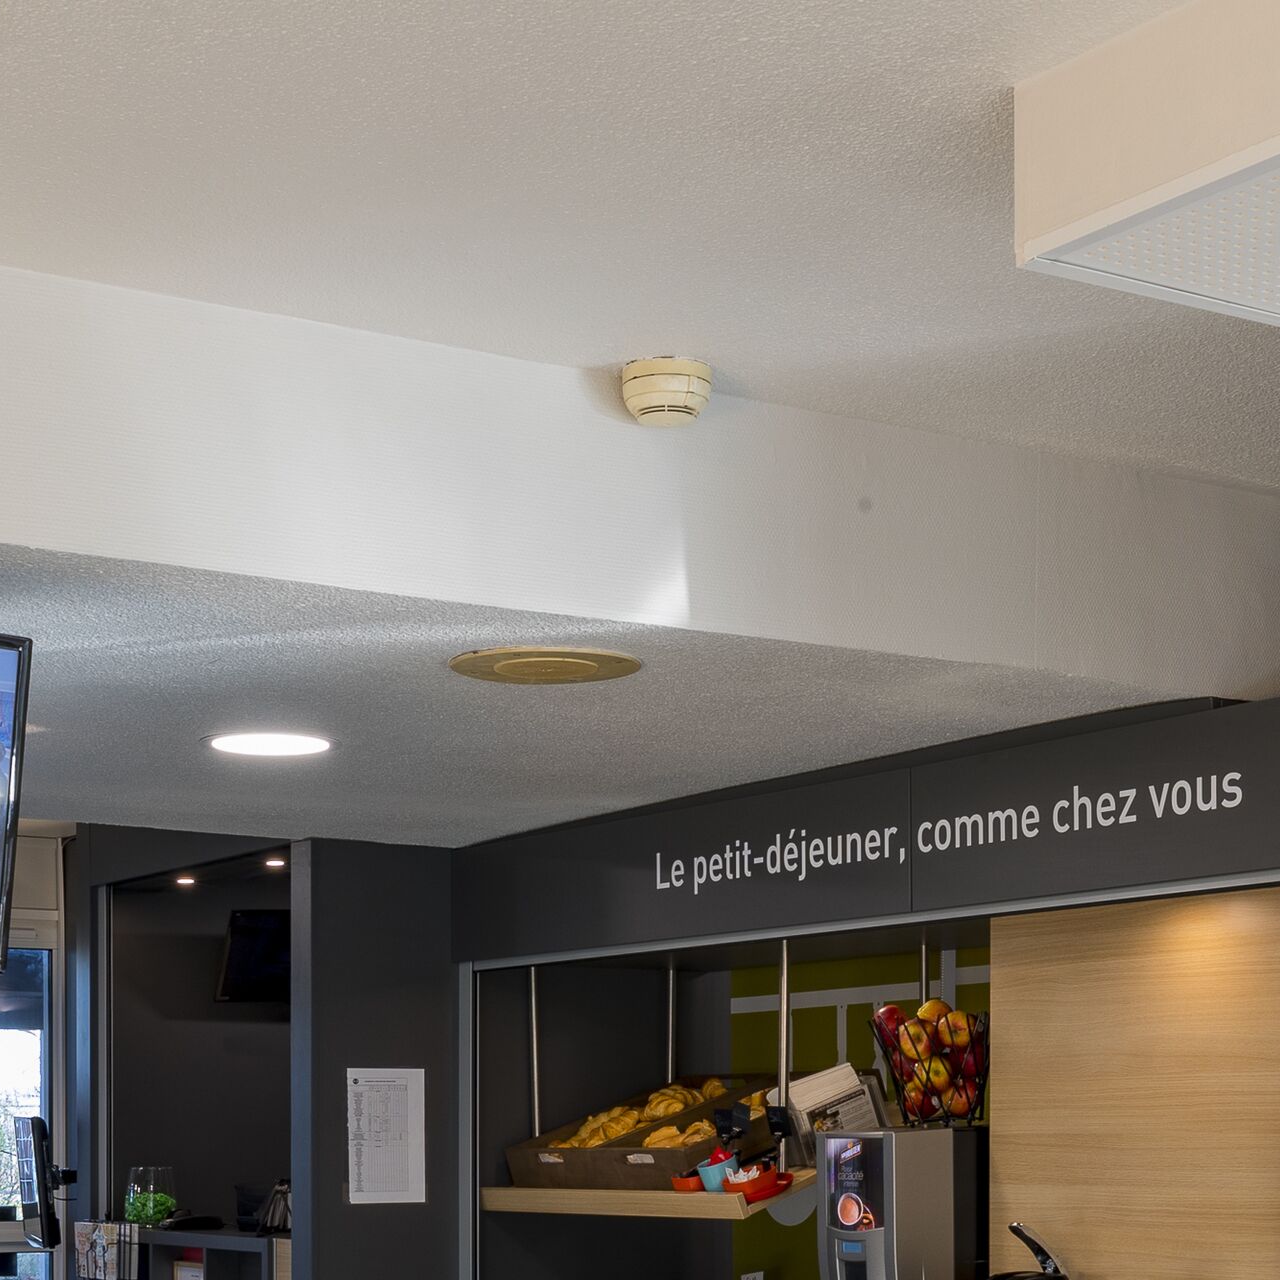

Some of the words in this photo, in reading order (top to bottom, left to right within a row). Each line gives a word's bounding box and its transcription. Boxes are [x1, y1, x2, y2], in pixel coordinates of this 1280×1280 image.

[656, 853, 685, 889] Le
[693, 826, 906, 895] petit-déjeuner,
[917, 804, 1040, 853] comme
[1052, 785, 1137, 833] chez
[1148, 772, 1243, 819] vous
